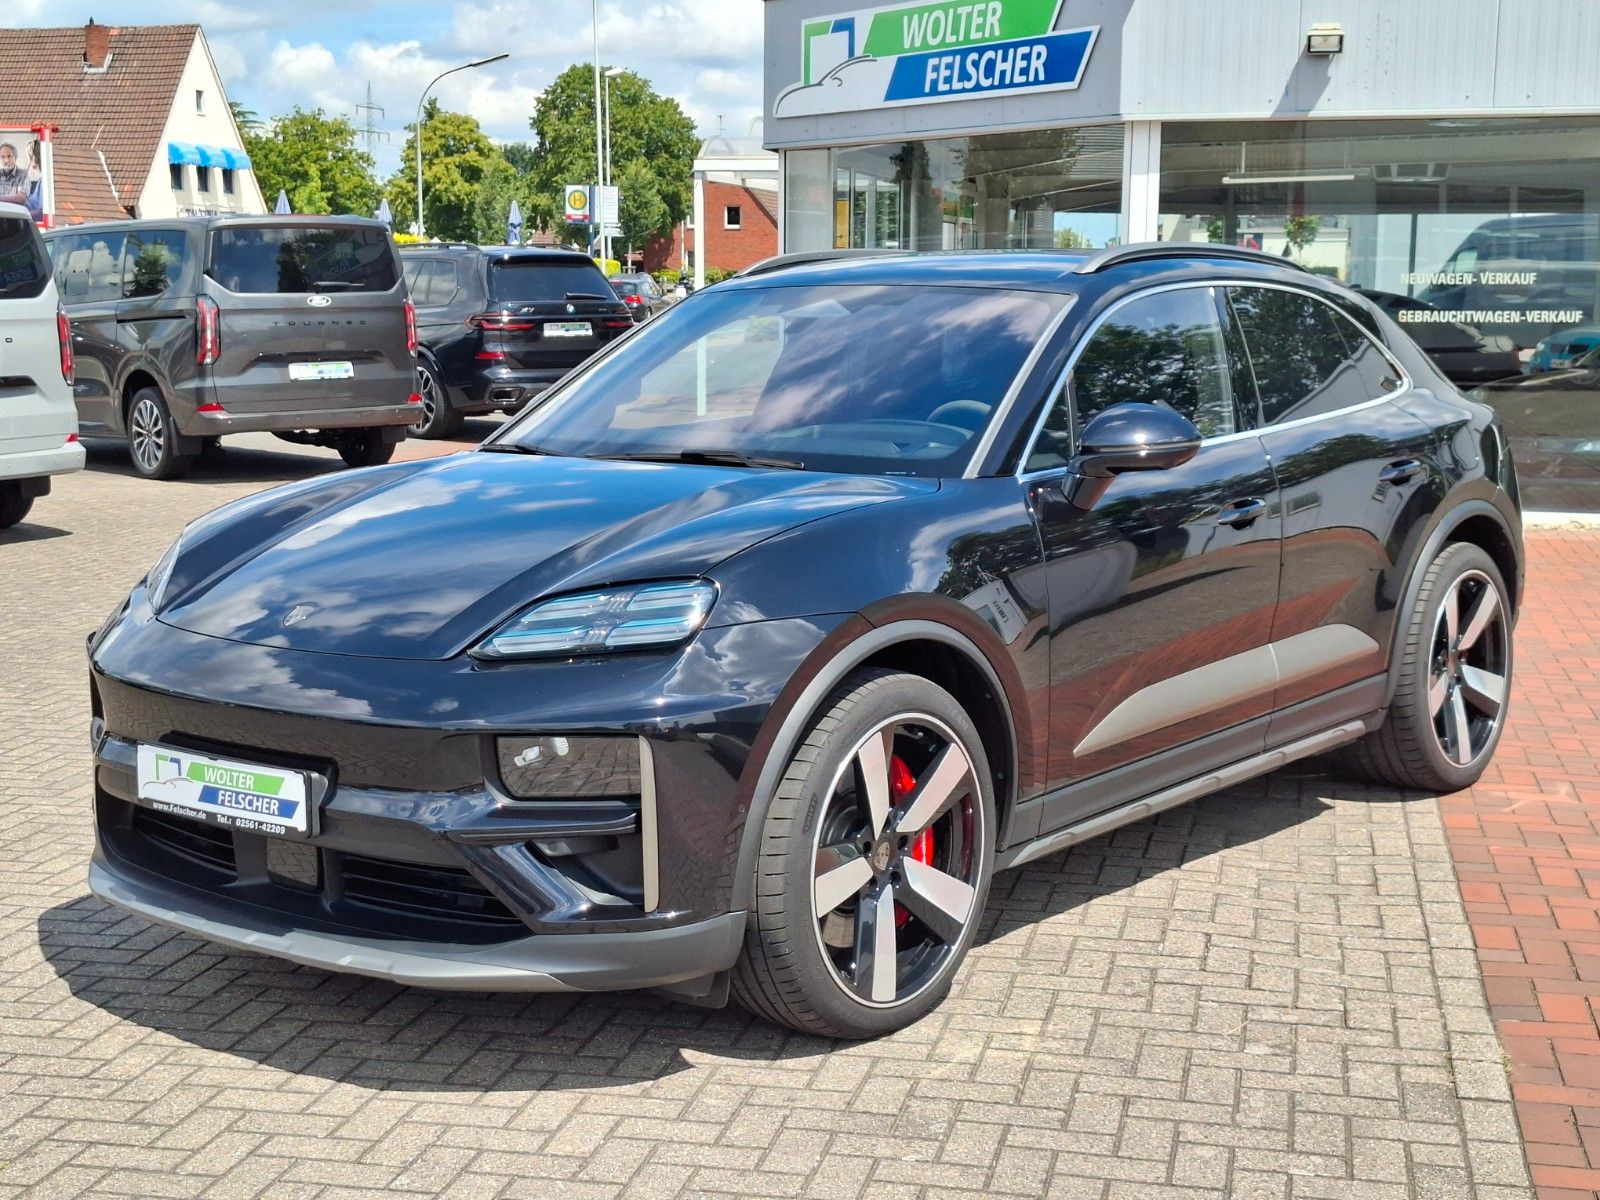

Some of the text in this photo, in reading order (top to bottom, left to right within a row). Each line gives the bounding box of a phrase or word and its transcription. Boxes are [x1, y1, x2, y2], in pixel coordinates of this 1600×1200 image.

[903, 1, 1002, 49] WOLTER
[924, 44, 1048, 93] FELSCHER
[1400, 272, 1537, 285] NEUWAGEN- VERKAUF
[1398, 310, 1583, 323] GEBRAUCHTWAGEN-VERKAUF
[204, 767, 255, 790] WOLTER
[218, 790, 279, 815] FELSCHER
[153, 802, 286, 835] www.Felscher.de Tel.: 02561-42209
